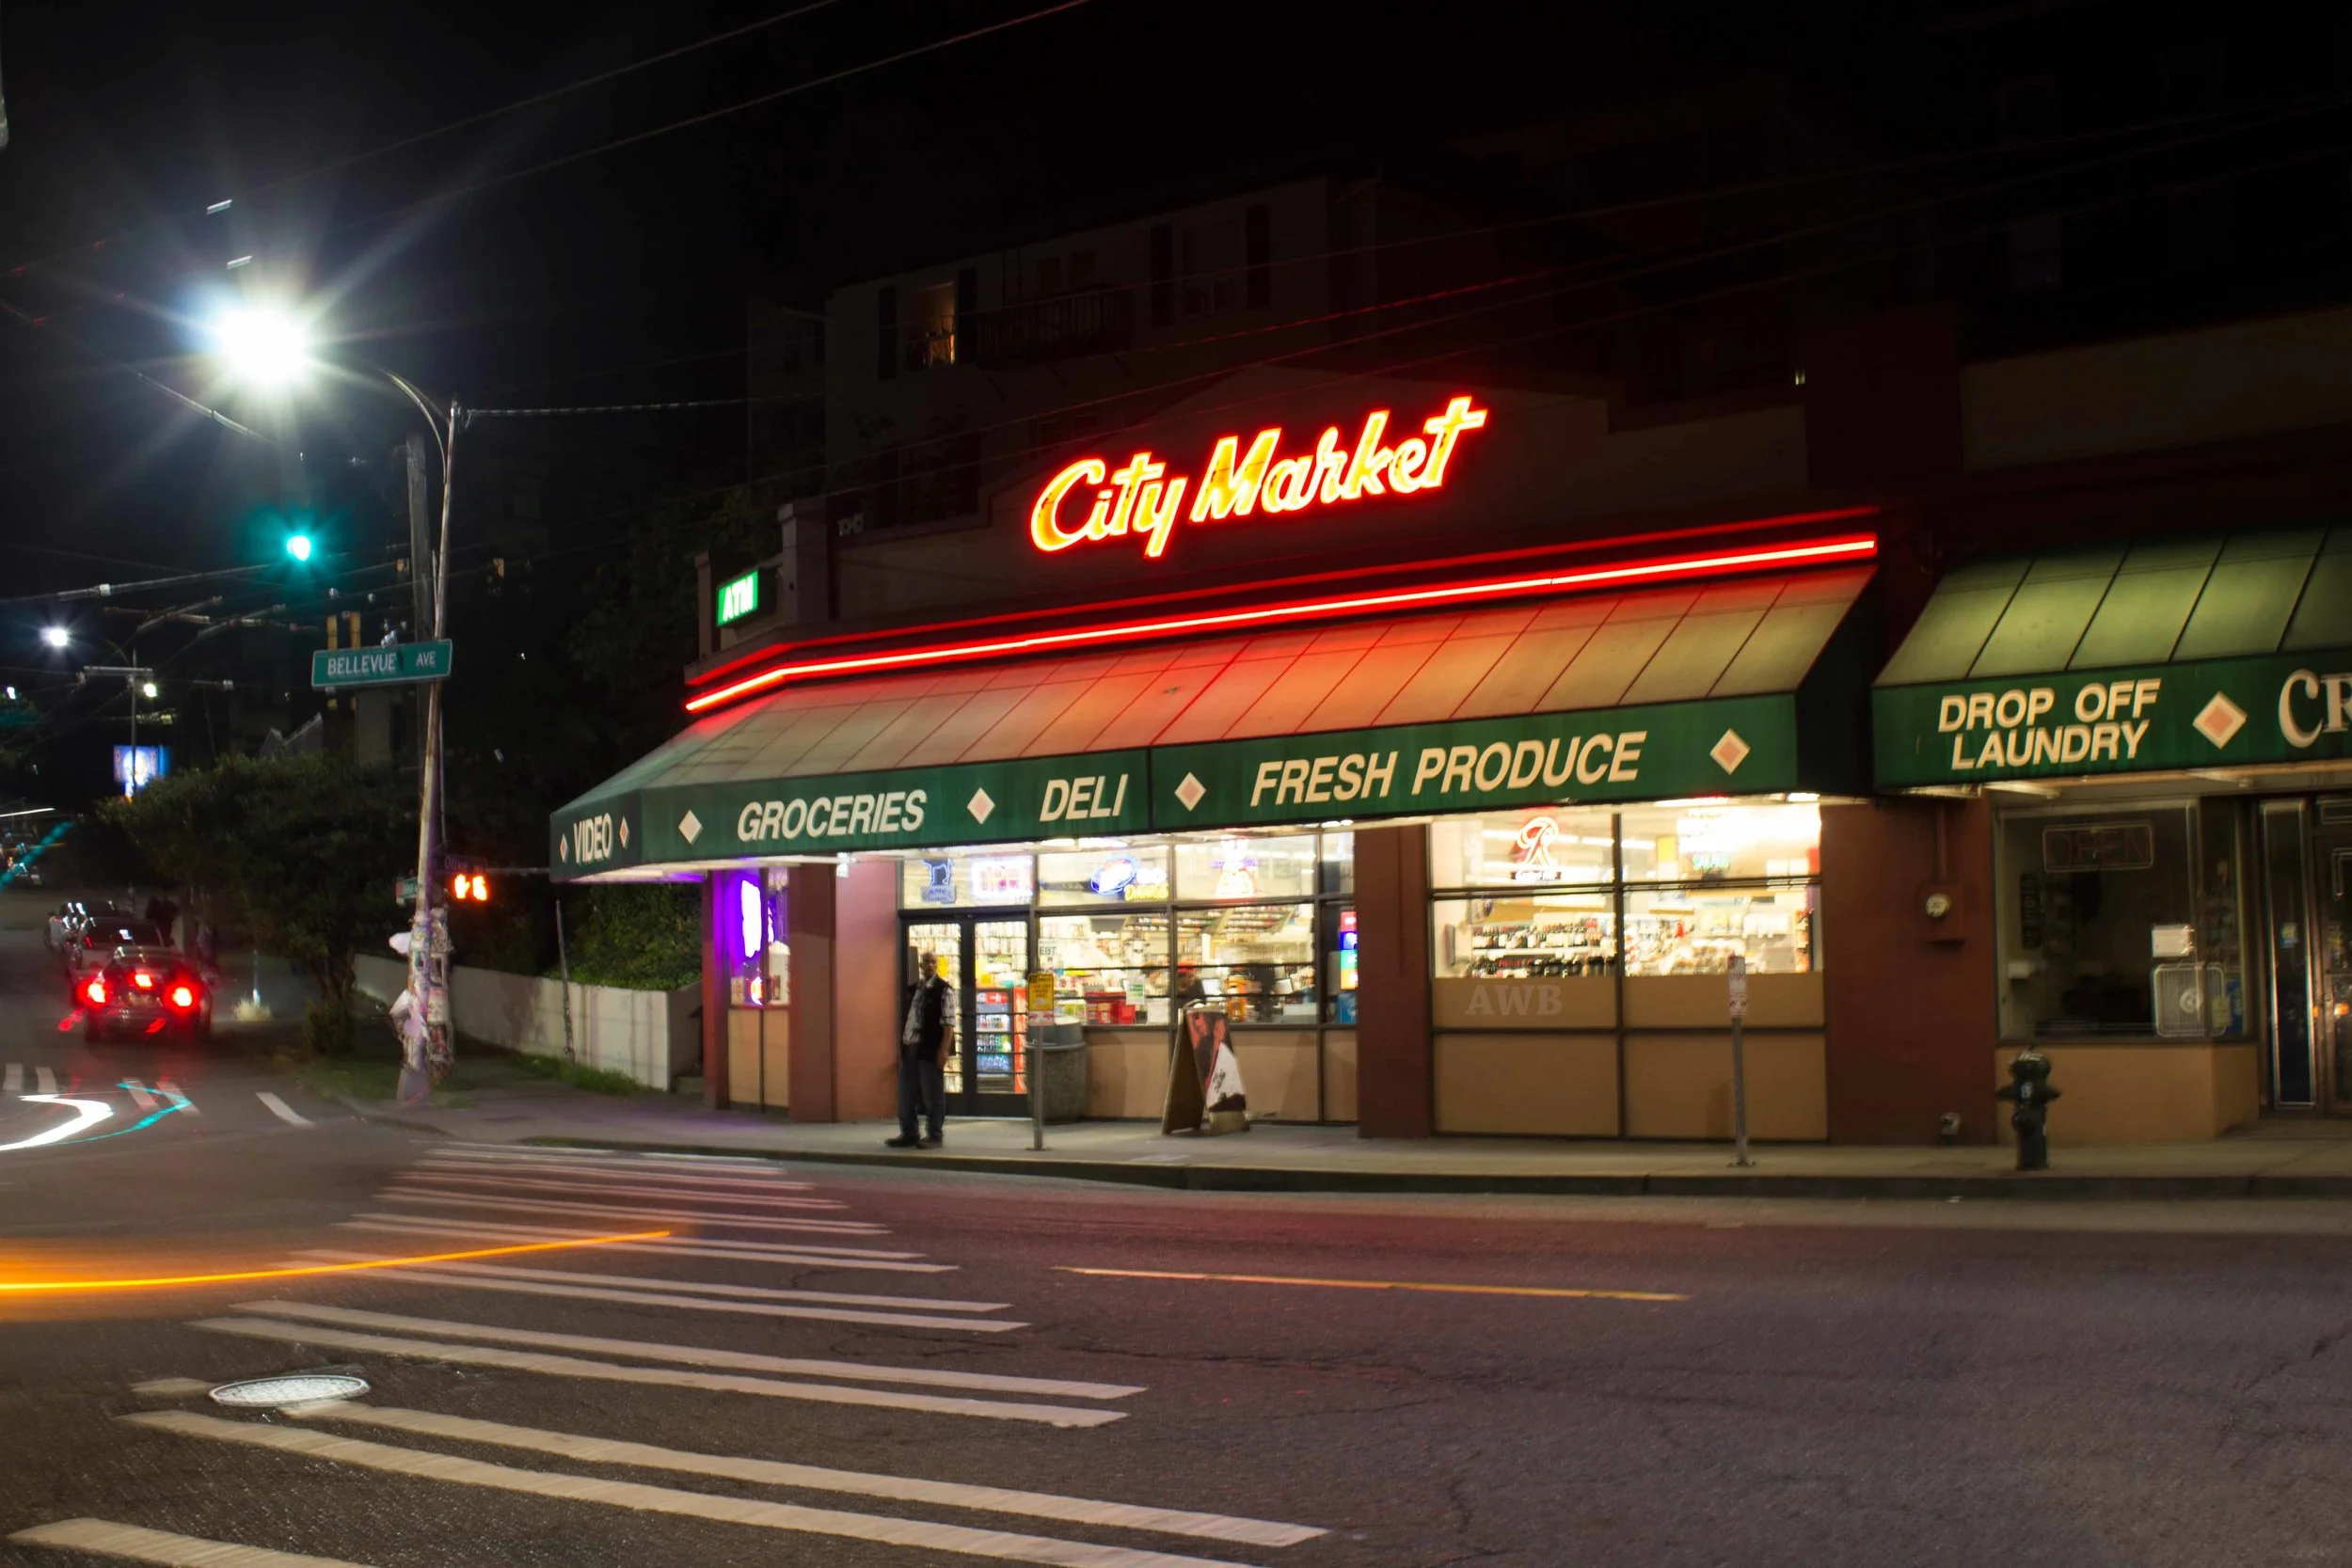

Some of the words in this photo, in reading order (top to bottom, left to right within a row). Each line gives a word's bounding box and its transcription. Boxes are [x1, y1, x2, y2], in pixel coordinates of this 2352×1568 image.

[1030, 451, 1188, 558] City
[1189, 395, 1488, 523] Market
[327, 653, 397, 675] BELLEVUE
[416, 651, 436, 668] AVE
[1938, 687, 2055, 734] DROP
[2074, 678, 2162, 723] OFF
[1249, 752, 1399, 808] FRESH
[1412, 731, 1647, 796] PRODUCE
[1951, 720, 2150, 770] LAUNDRY
[737, 789, 928, 842] GROCERIES
[1040, 774, 1129, 823] DELI
[574, 813, 613, 865] VIDEO
[2047, 830, 2149, 865] OPEN
[1039, 946, 1057, 956] EBT
